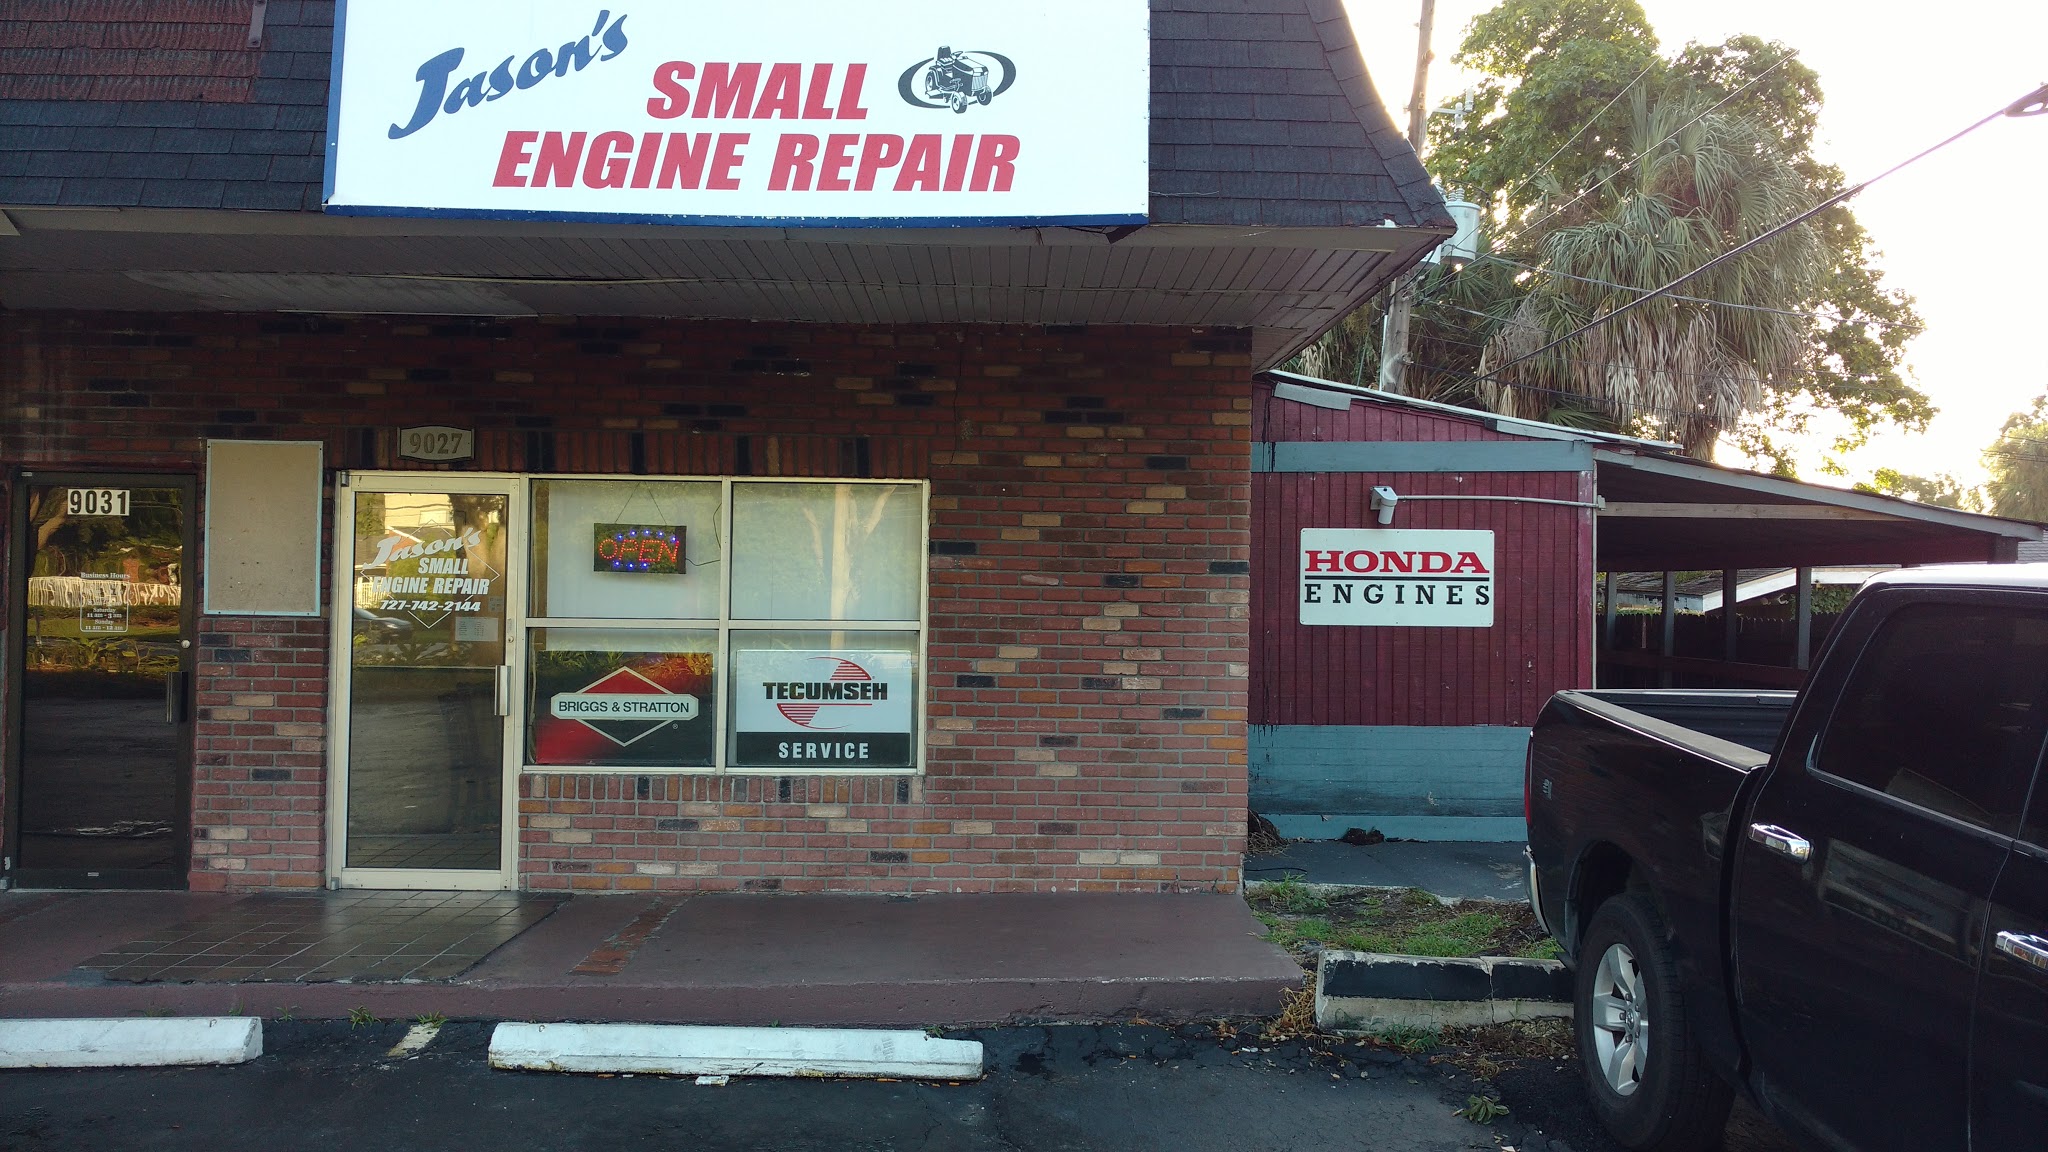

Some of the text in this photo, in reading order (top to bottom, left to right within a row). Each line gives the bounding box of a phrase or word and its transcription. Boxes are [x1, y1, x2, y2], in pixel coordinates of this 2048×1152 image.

[387, 9, 629, 140] Jason's
[645, 61, 869, 120] SMALL
[491, 130, 1021, 193] ENGINE REPAIR
[409, 432, 463, 454] 9027
[69, 490, 127, 514] 9031
[361, 527, 482, 570] Jason's
[598, 538, 680, 563] OPEN
[418, 557, 469, 575] SMALL
[1304, 549, 1490, 574] HONDA
[372, 576, 490, 595] ENGINE REPAIR
[1304, 583, 1490, 606] ENGINES
[379, 600, 482, 612] 727-742-2144
[762, 681, 888, 700] TECUMSEH
[558, 701, 689, 713] BRIGGS & STRATTON
[778, 741, 869, 760] SERVICE
